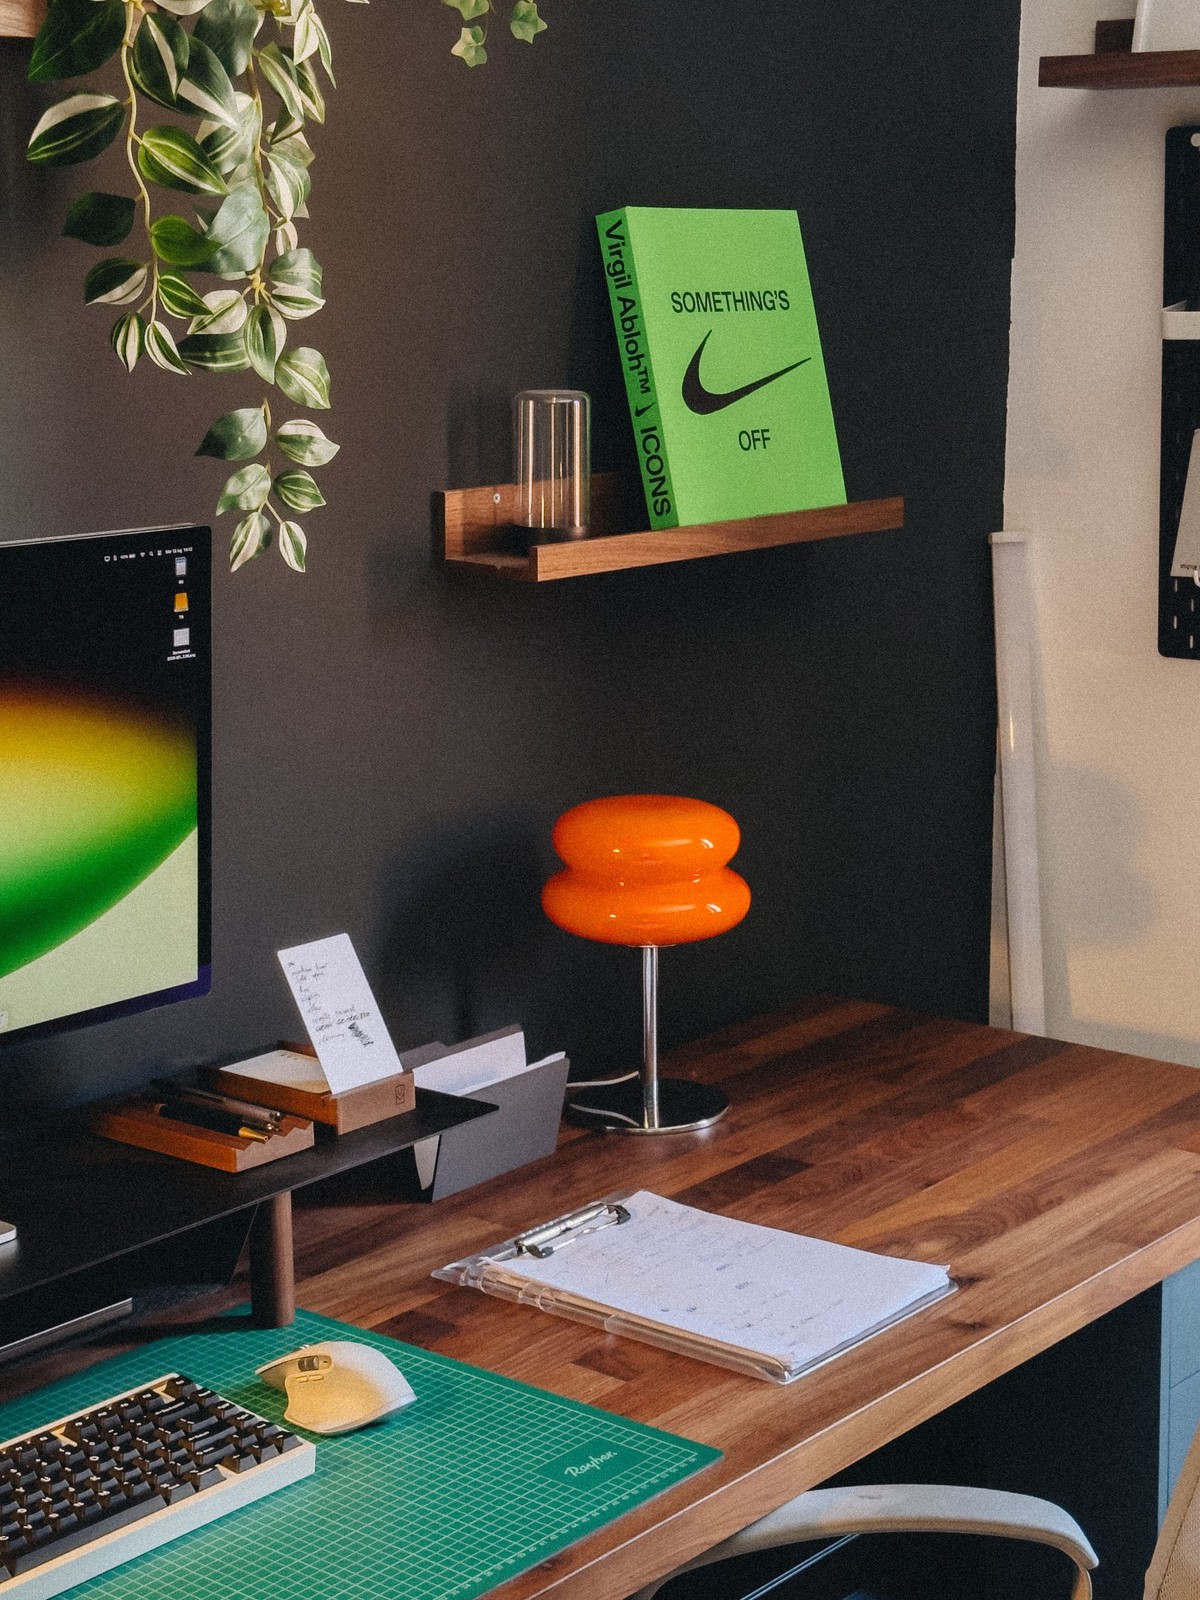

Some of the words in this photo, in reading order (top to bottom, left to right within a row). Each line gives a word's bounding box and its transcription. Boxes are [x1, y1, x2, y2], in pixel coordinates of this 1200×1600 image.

[671, 290, 790, 313] SOMETHING'S
[605, 219, 633, 290] Virgil
[640, 426, 672, 517] ICONS
[738, 428, 771, 451] OFF
